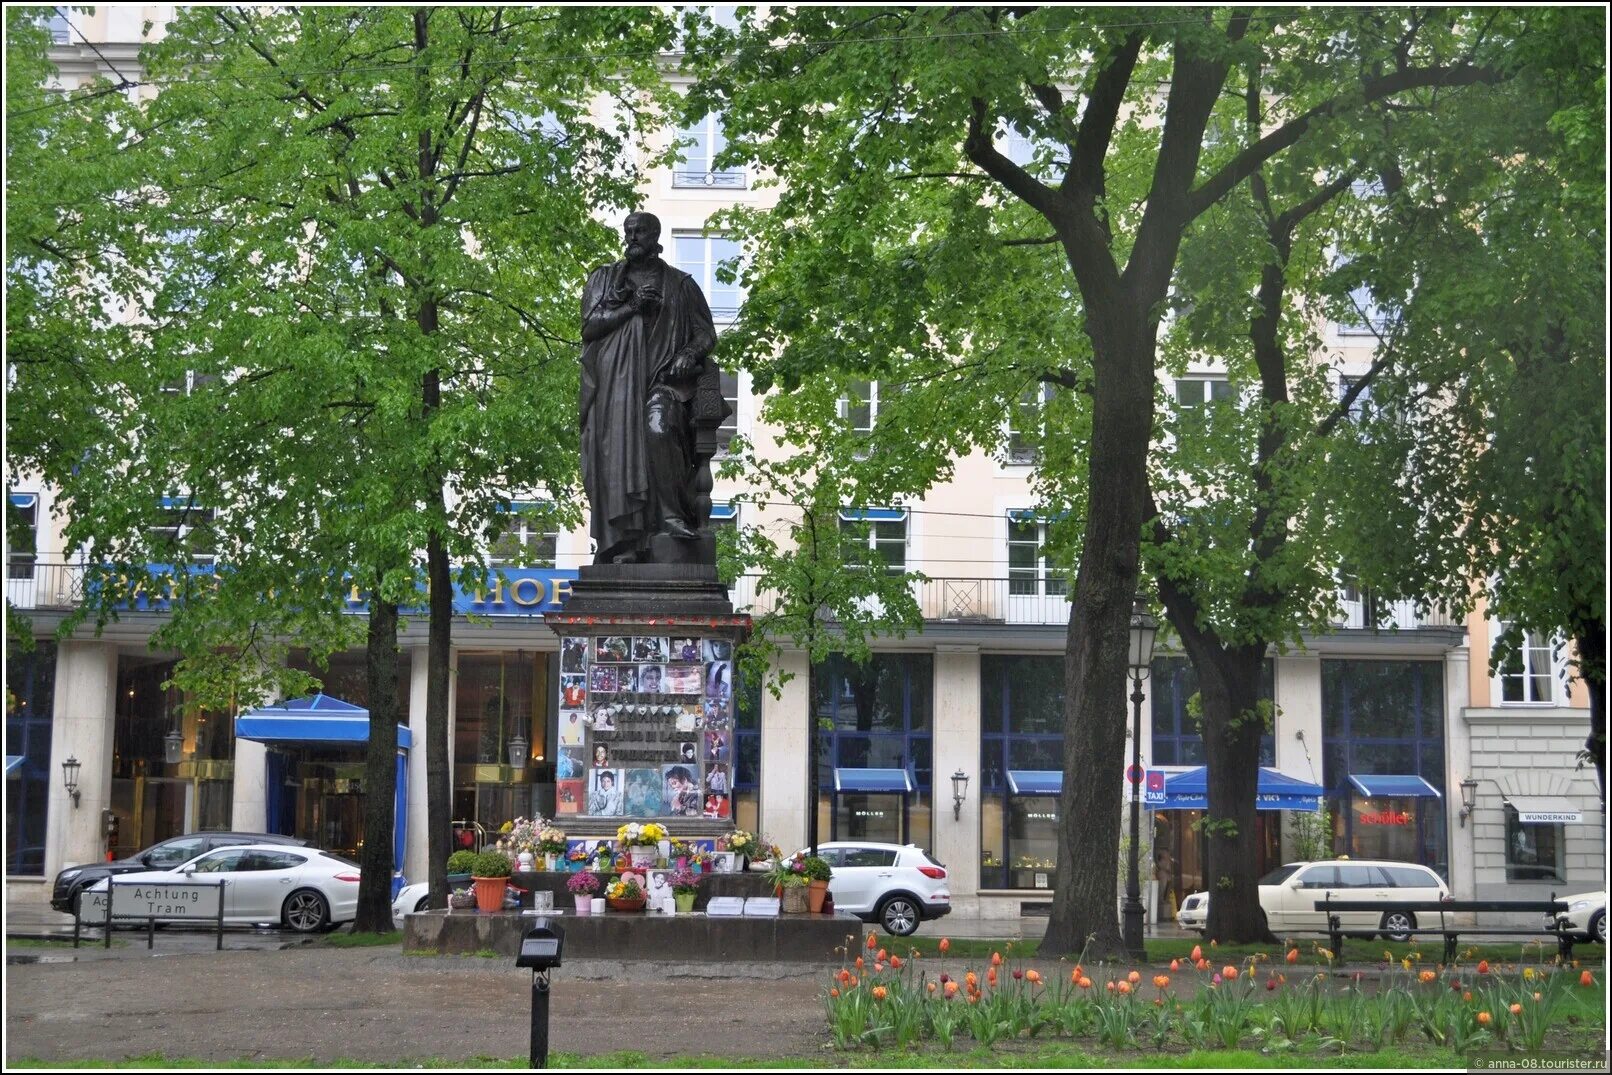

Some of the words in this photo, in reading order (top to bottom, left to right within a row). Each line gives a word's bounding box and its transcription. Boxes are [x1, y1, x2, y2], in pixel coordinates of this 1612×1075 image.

[1147, 791, 1164, 801] TAXI
[1524, 813, 1577, 821] WUNDERKIND
[134, 888, 199, 902] Achtung
[147, 901, 186, 914] Tram
